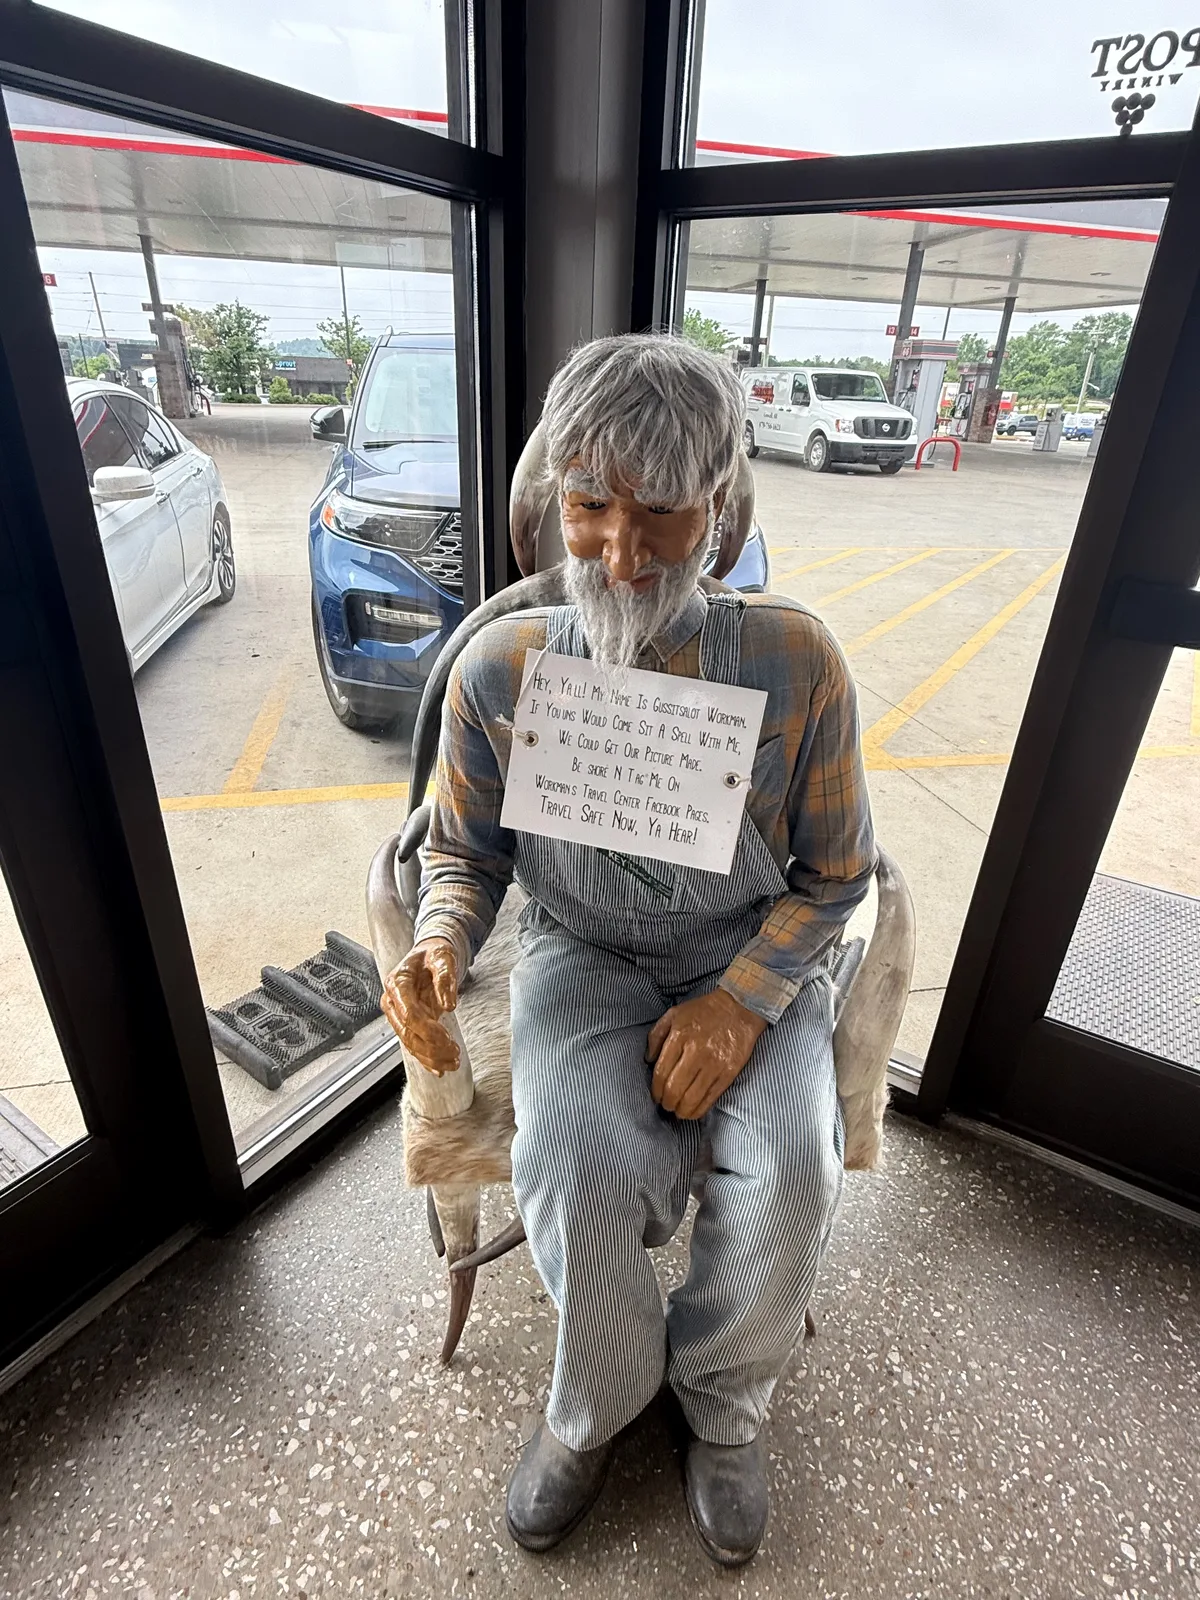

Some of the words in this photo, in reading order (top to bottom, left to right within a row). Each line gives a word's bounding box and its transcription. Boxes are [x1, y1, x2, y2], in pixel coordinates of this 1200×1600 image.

[529, 699, 540, 714] IF
[582, 708, 608, 727] WOULD
[612, 715, 633, 733] COME
[638, 720, 654, 736] SIT
[658, 723, 666, 739] A
[671, 726, 691, 744] SPELL
[699, 731, 722, 749] WITH
[725, 736, 741, 756] ME,
[636, 694, 648, 710] IS
[707, 706, 747, 729] WORKMAN.
[559, 729, 573, 746] WE
[577, 733, 600, 751] COULD
[604, 739, 619, 755] GET
[624, 742, 640, 759] OUR
[644, 746, 674, 766] PICTURE
[679, 753, 702, 772] MADE.
[571, 756, 583, 773] BE
[614, 765, 623, 781] N
[649, 772, 663, 789] ME
[668, 776, 681, 792] ON
[541, 794, 572, 820] TRAVEL
[581, 804, 605, 826] SAFE
[612, 809, 638, 836] NOW,
[648, 816, 662, 838] YA
[668, 821, 698, 845] HEAR!
[583, 783, 607, 803] TRAVEL
[613, 790, 640, 809] CENTER
[645, 796, 681, 817] FACEBOOK
